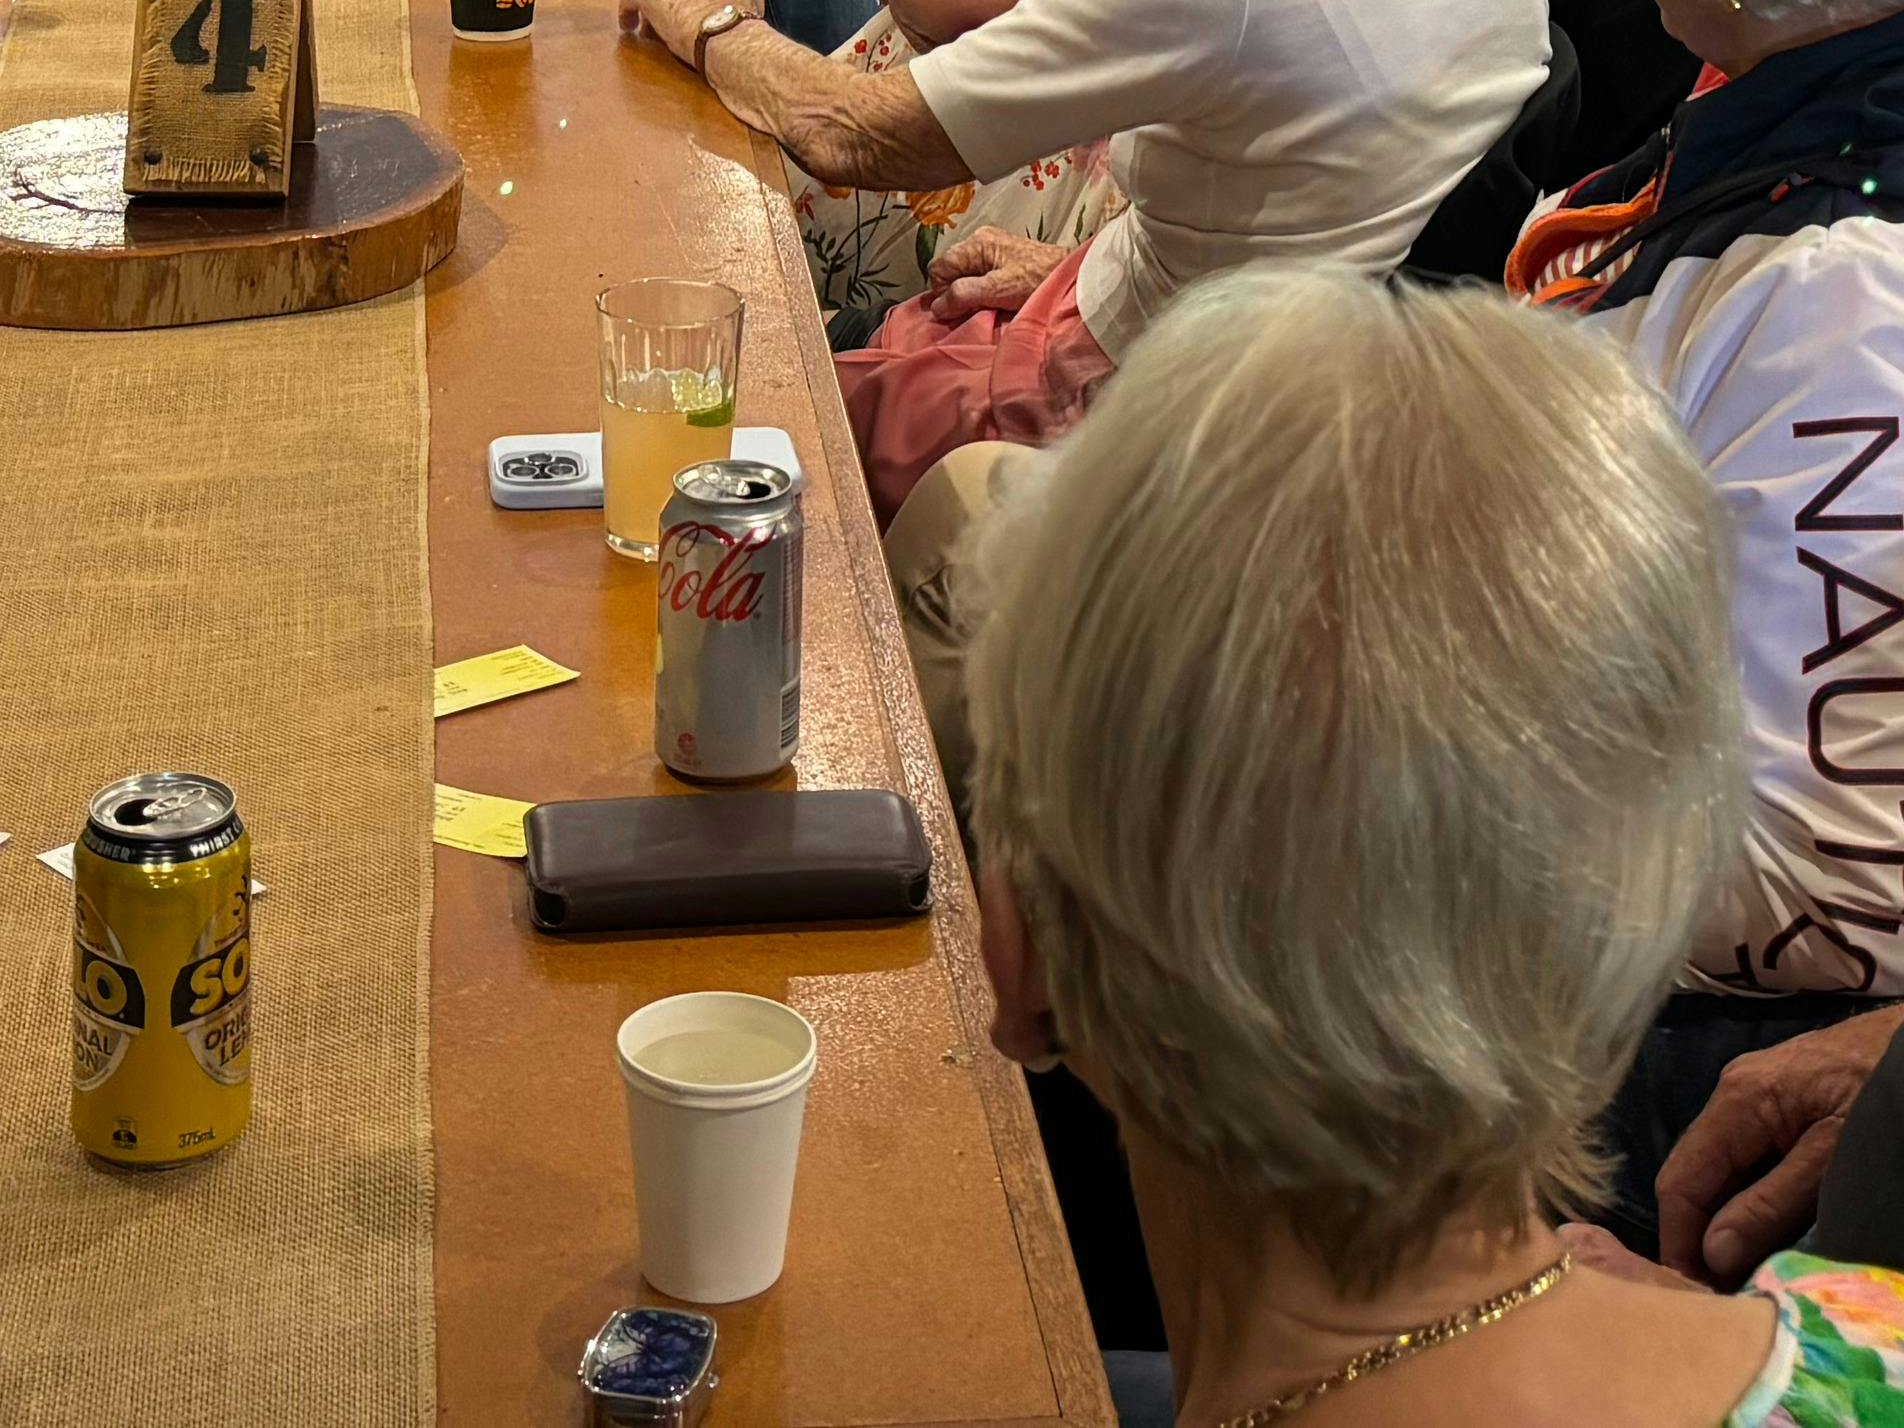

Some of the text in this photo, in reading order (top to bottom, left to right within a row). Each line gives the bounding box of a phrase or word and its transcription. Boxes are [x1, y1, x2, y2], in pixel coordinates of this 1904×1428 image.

[658, 519, 772, 623] Cola
[189, 829, 235, 858] THIRST
[177, 1126, 218, 1150] 375mL
